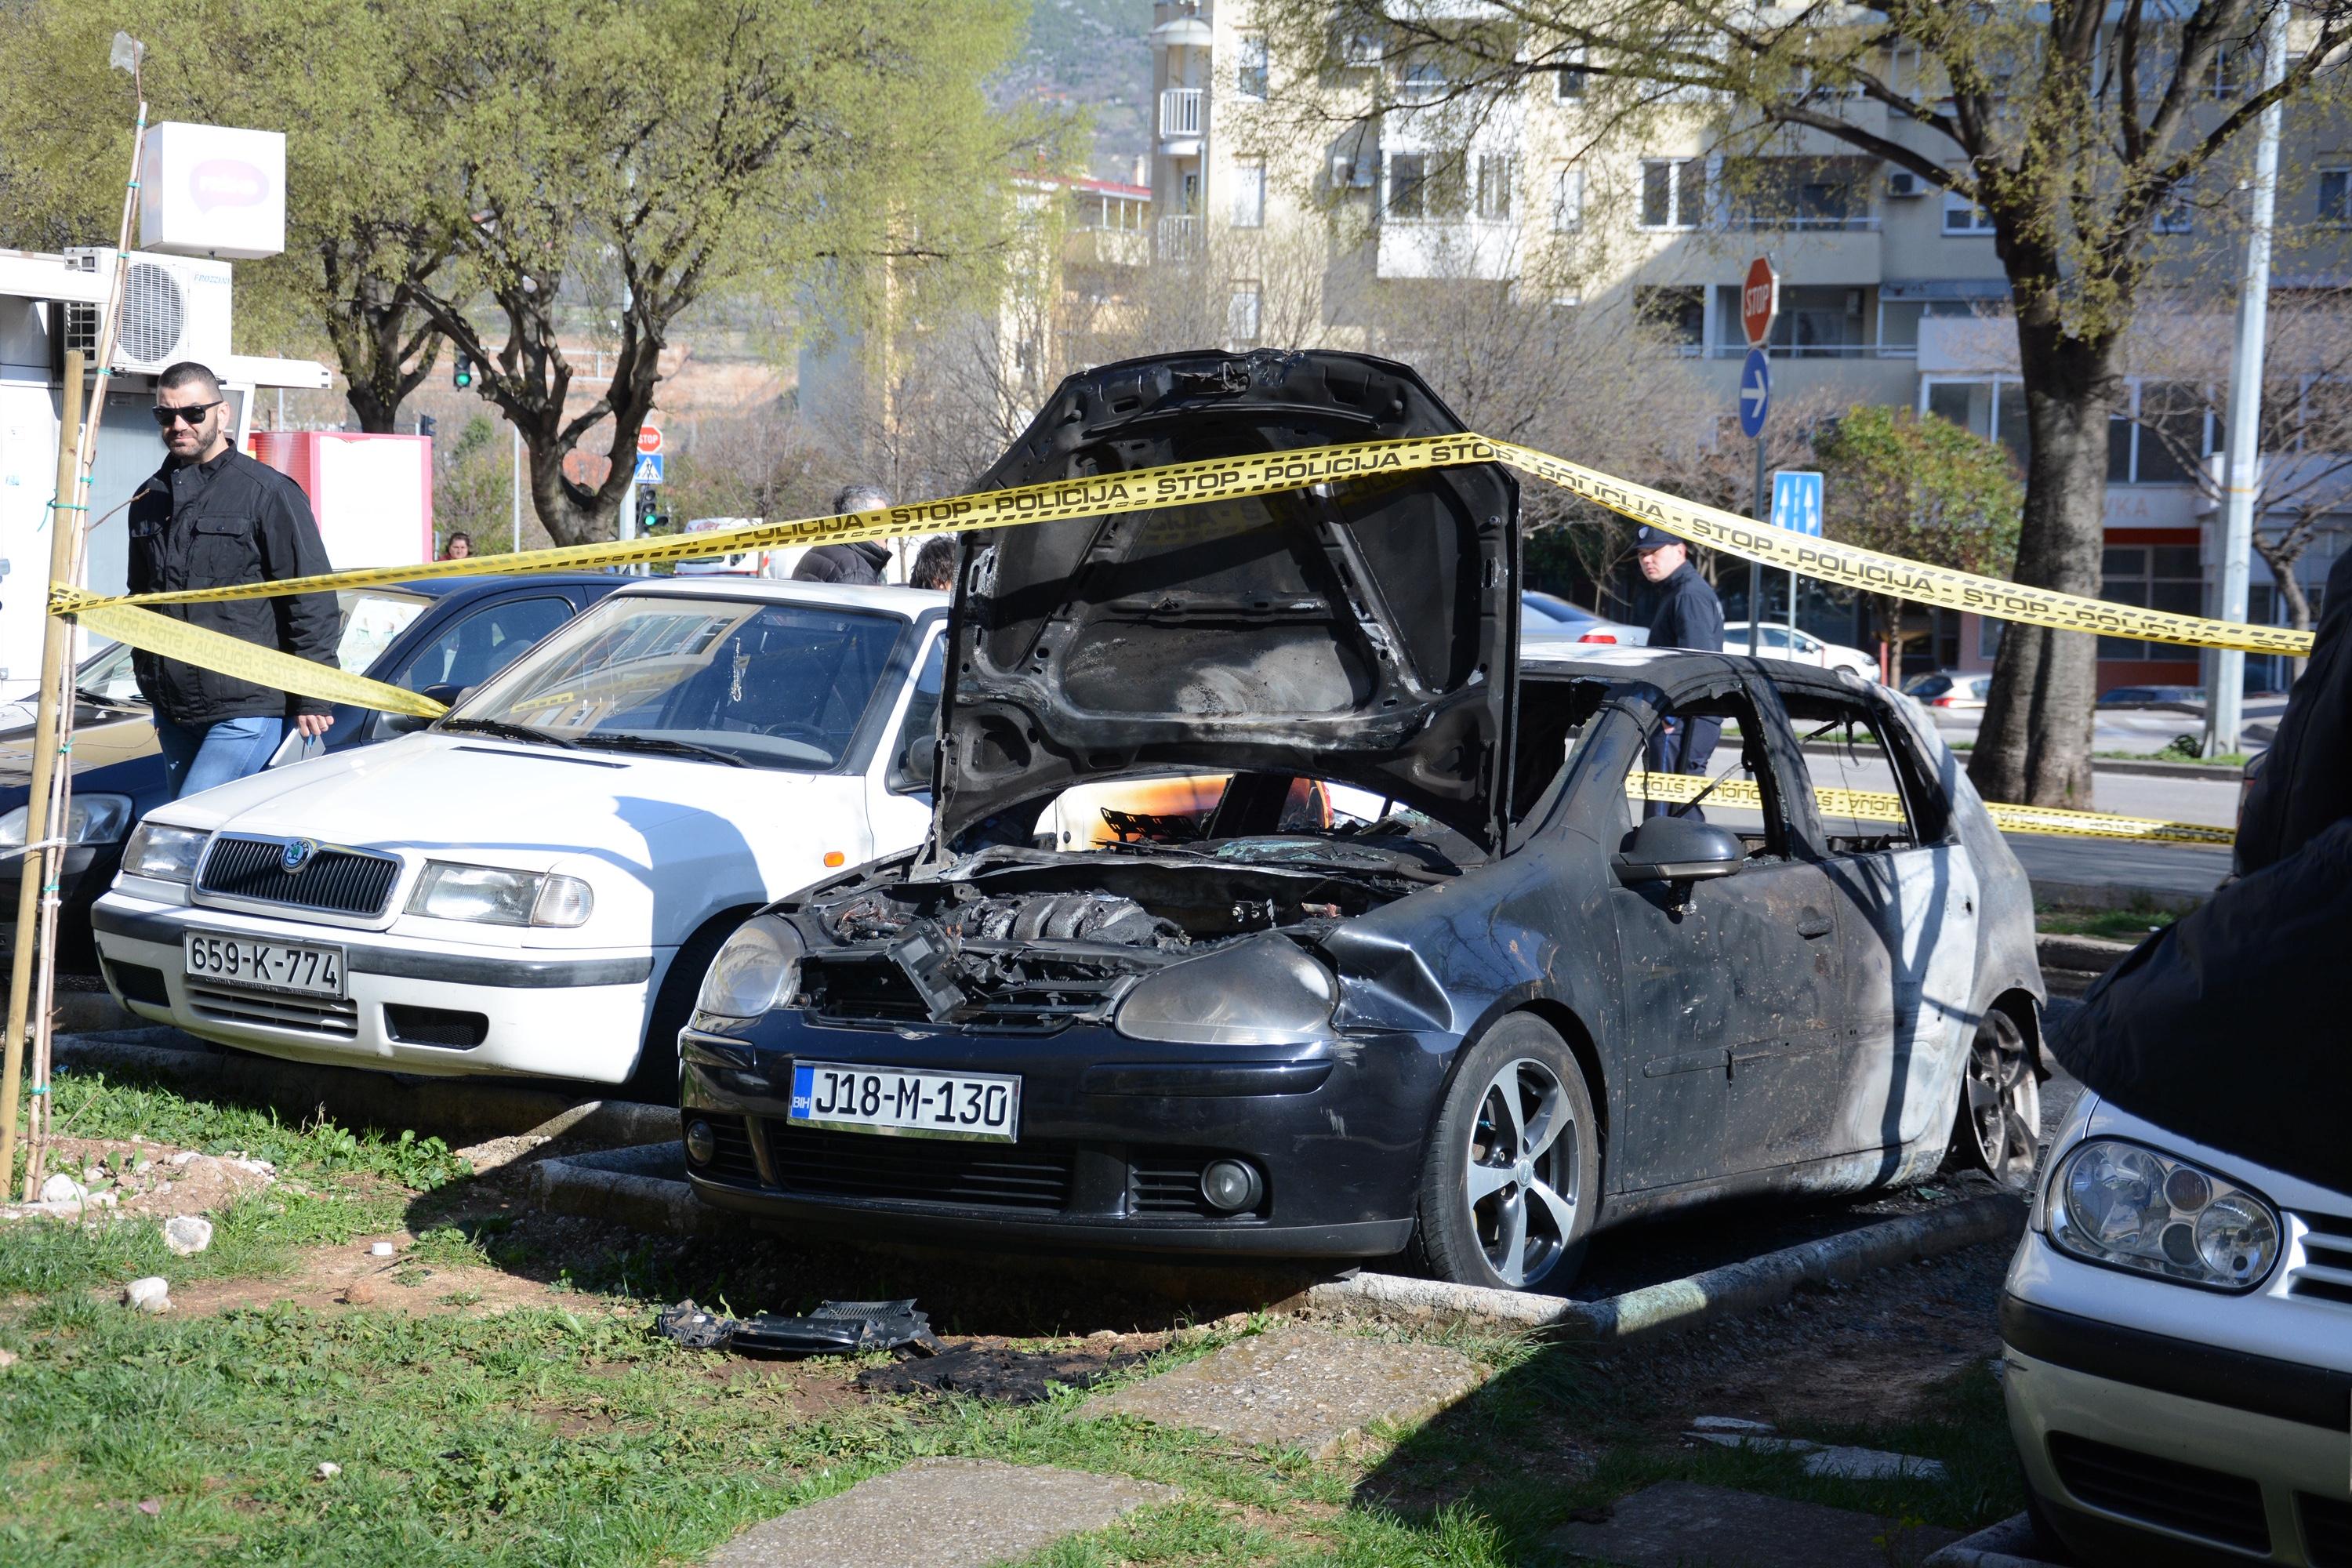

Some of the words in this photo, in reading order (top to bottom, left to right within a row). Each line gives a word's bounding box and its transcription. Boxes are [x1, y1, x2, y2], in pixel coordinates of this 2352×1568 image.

[1745, 284, 1769, 317] STOP
[638, 434, 659, 445] STOP
[891, 502, 971, 524] STOP
[995, 483, 1130, 514] POLICIJA
[1157, 470, 1240, 495] STOP
[1264, 453, 1402, 481] POLICIJA
[1430, 441, 1514, 463] STOP
[1537, 465, 1664, 520] POLICIJA
[1692, 517, 1773, 552] STOP
[1798, 547, 1936, 593] POLICIJA
[1963, 586, 2050, 614] STOP
[1639, 780, 1685, 793] STOP
[192, 936, 337, 989] 659-K-774
[793, 1096, 810, 1109] BIH
[815, 1072, 1007, 1127] J18-M-130
